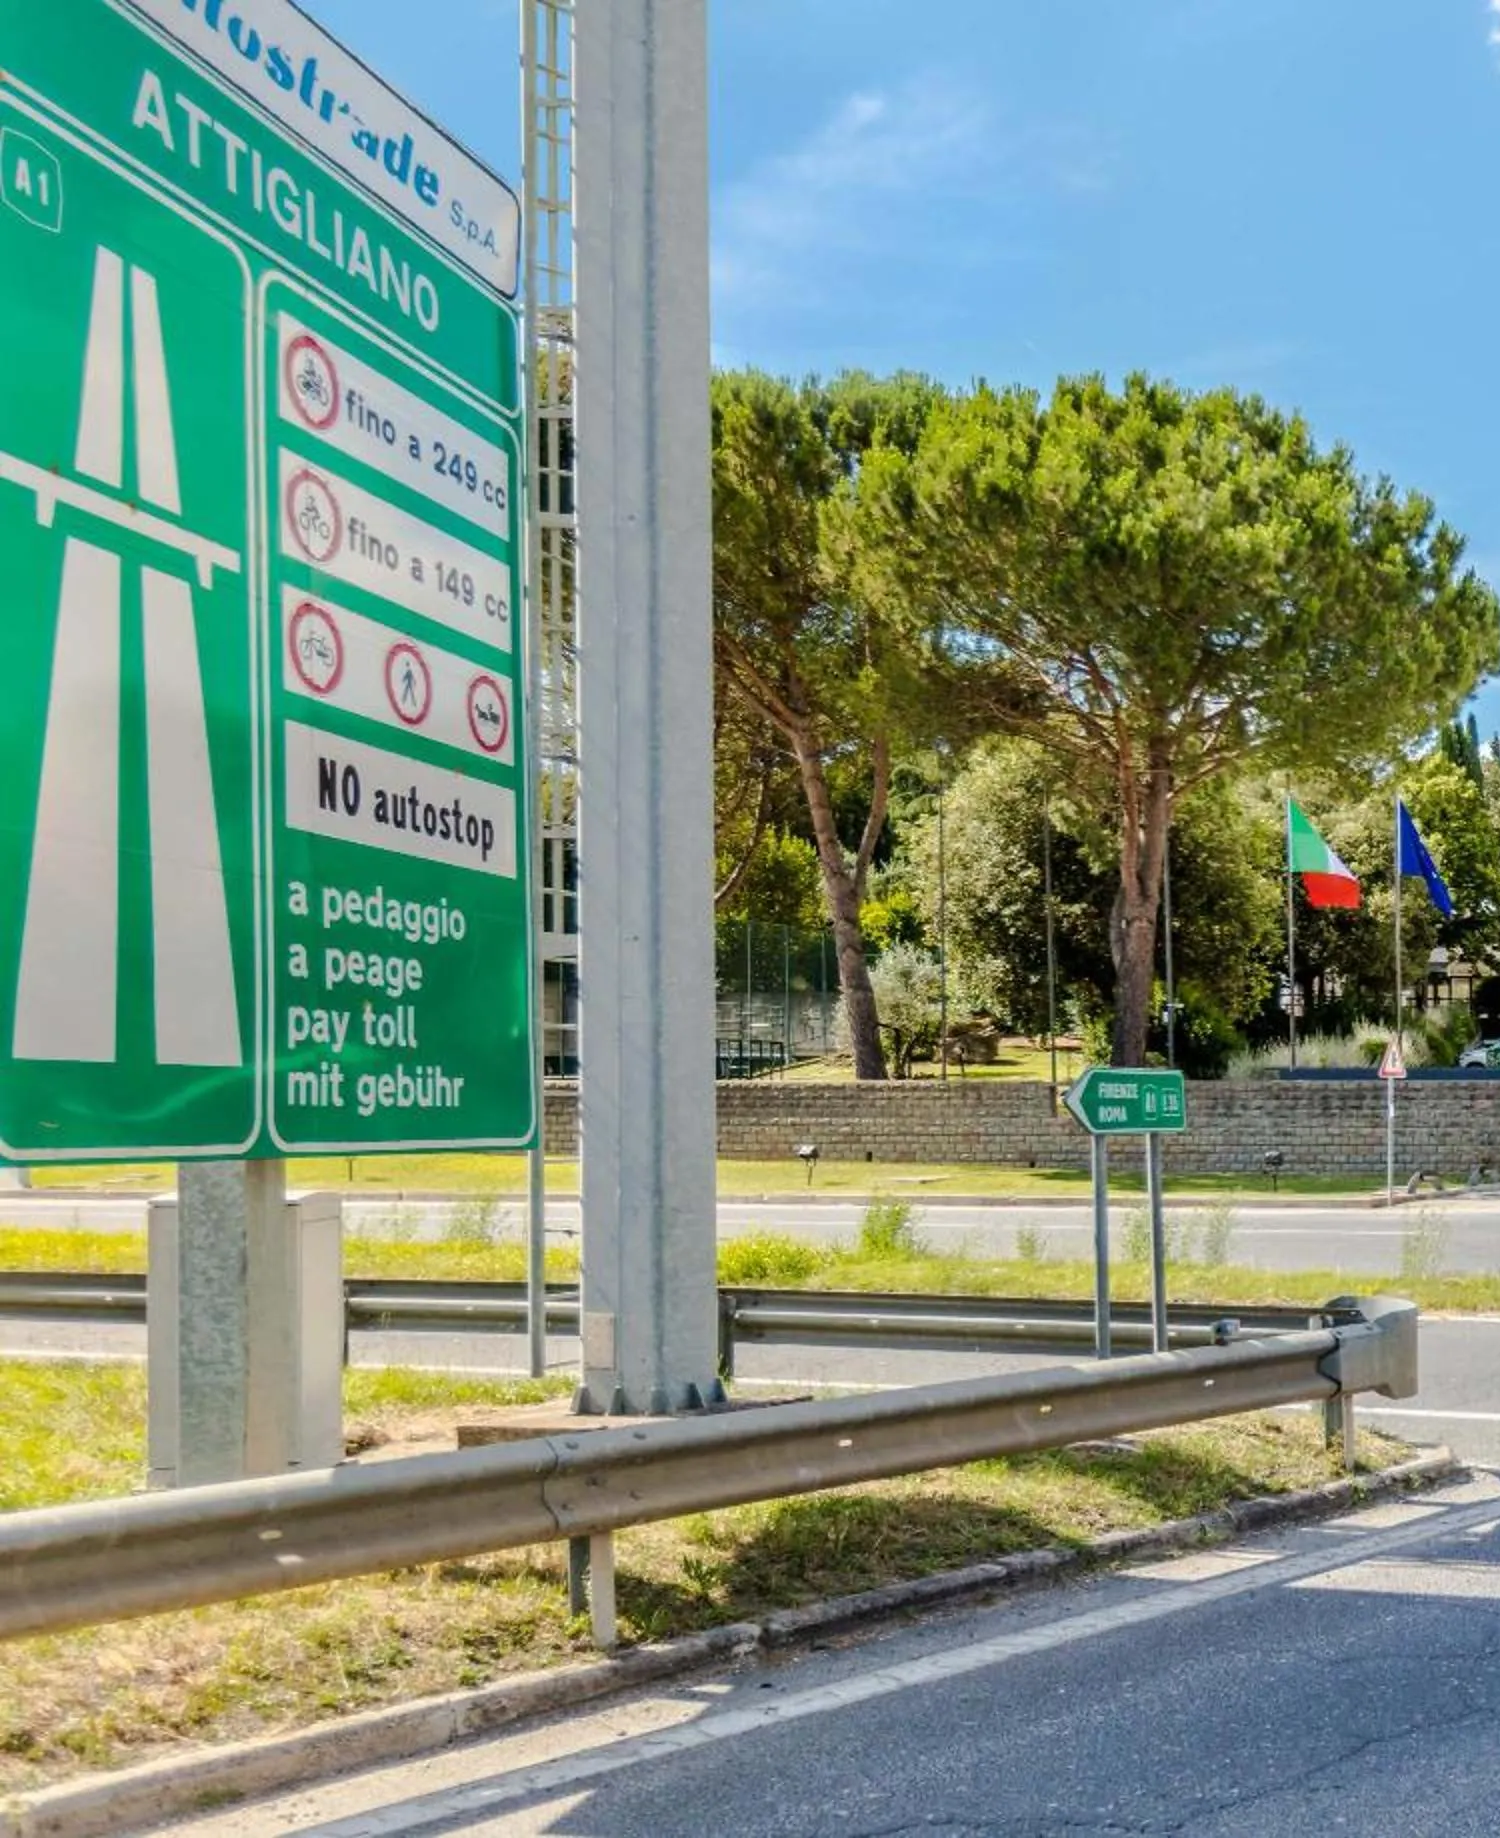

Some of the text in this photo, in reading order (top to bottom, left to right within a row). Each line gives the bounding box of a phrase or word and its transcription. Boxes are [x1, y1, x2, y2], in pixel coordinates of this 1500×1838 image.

[181, 0, 440, 207] tostrade
[15, 158, 49, 206] A1
[132, 69, 440, 332] ATTIGLIANO
[345, 389, 506, 510] fino a 249 cc
[348, 517, 508, 623] fino a 149 cc
[318, 757, 495, 862] NO autostop
[288, 881, 467, 945] a pedaggio
[288, 943, 423, 997] a peage
[288, 1001, 417, 1052] pay toll
[288, 1061, 464, 1117] mit gebühr
[1098, 1083, 1138, 1099] FIRENZE
[1098, 1105, 1127, 1122] ROMA
